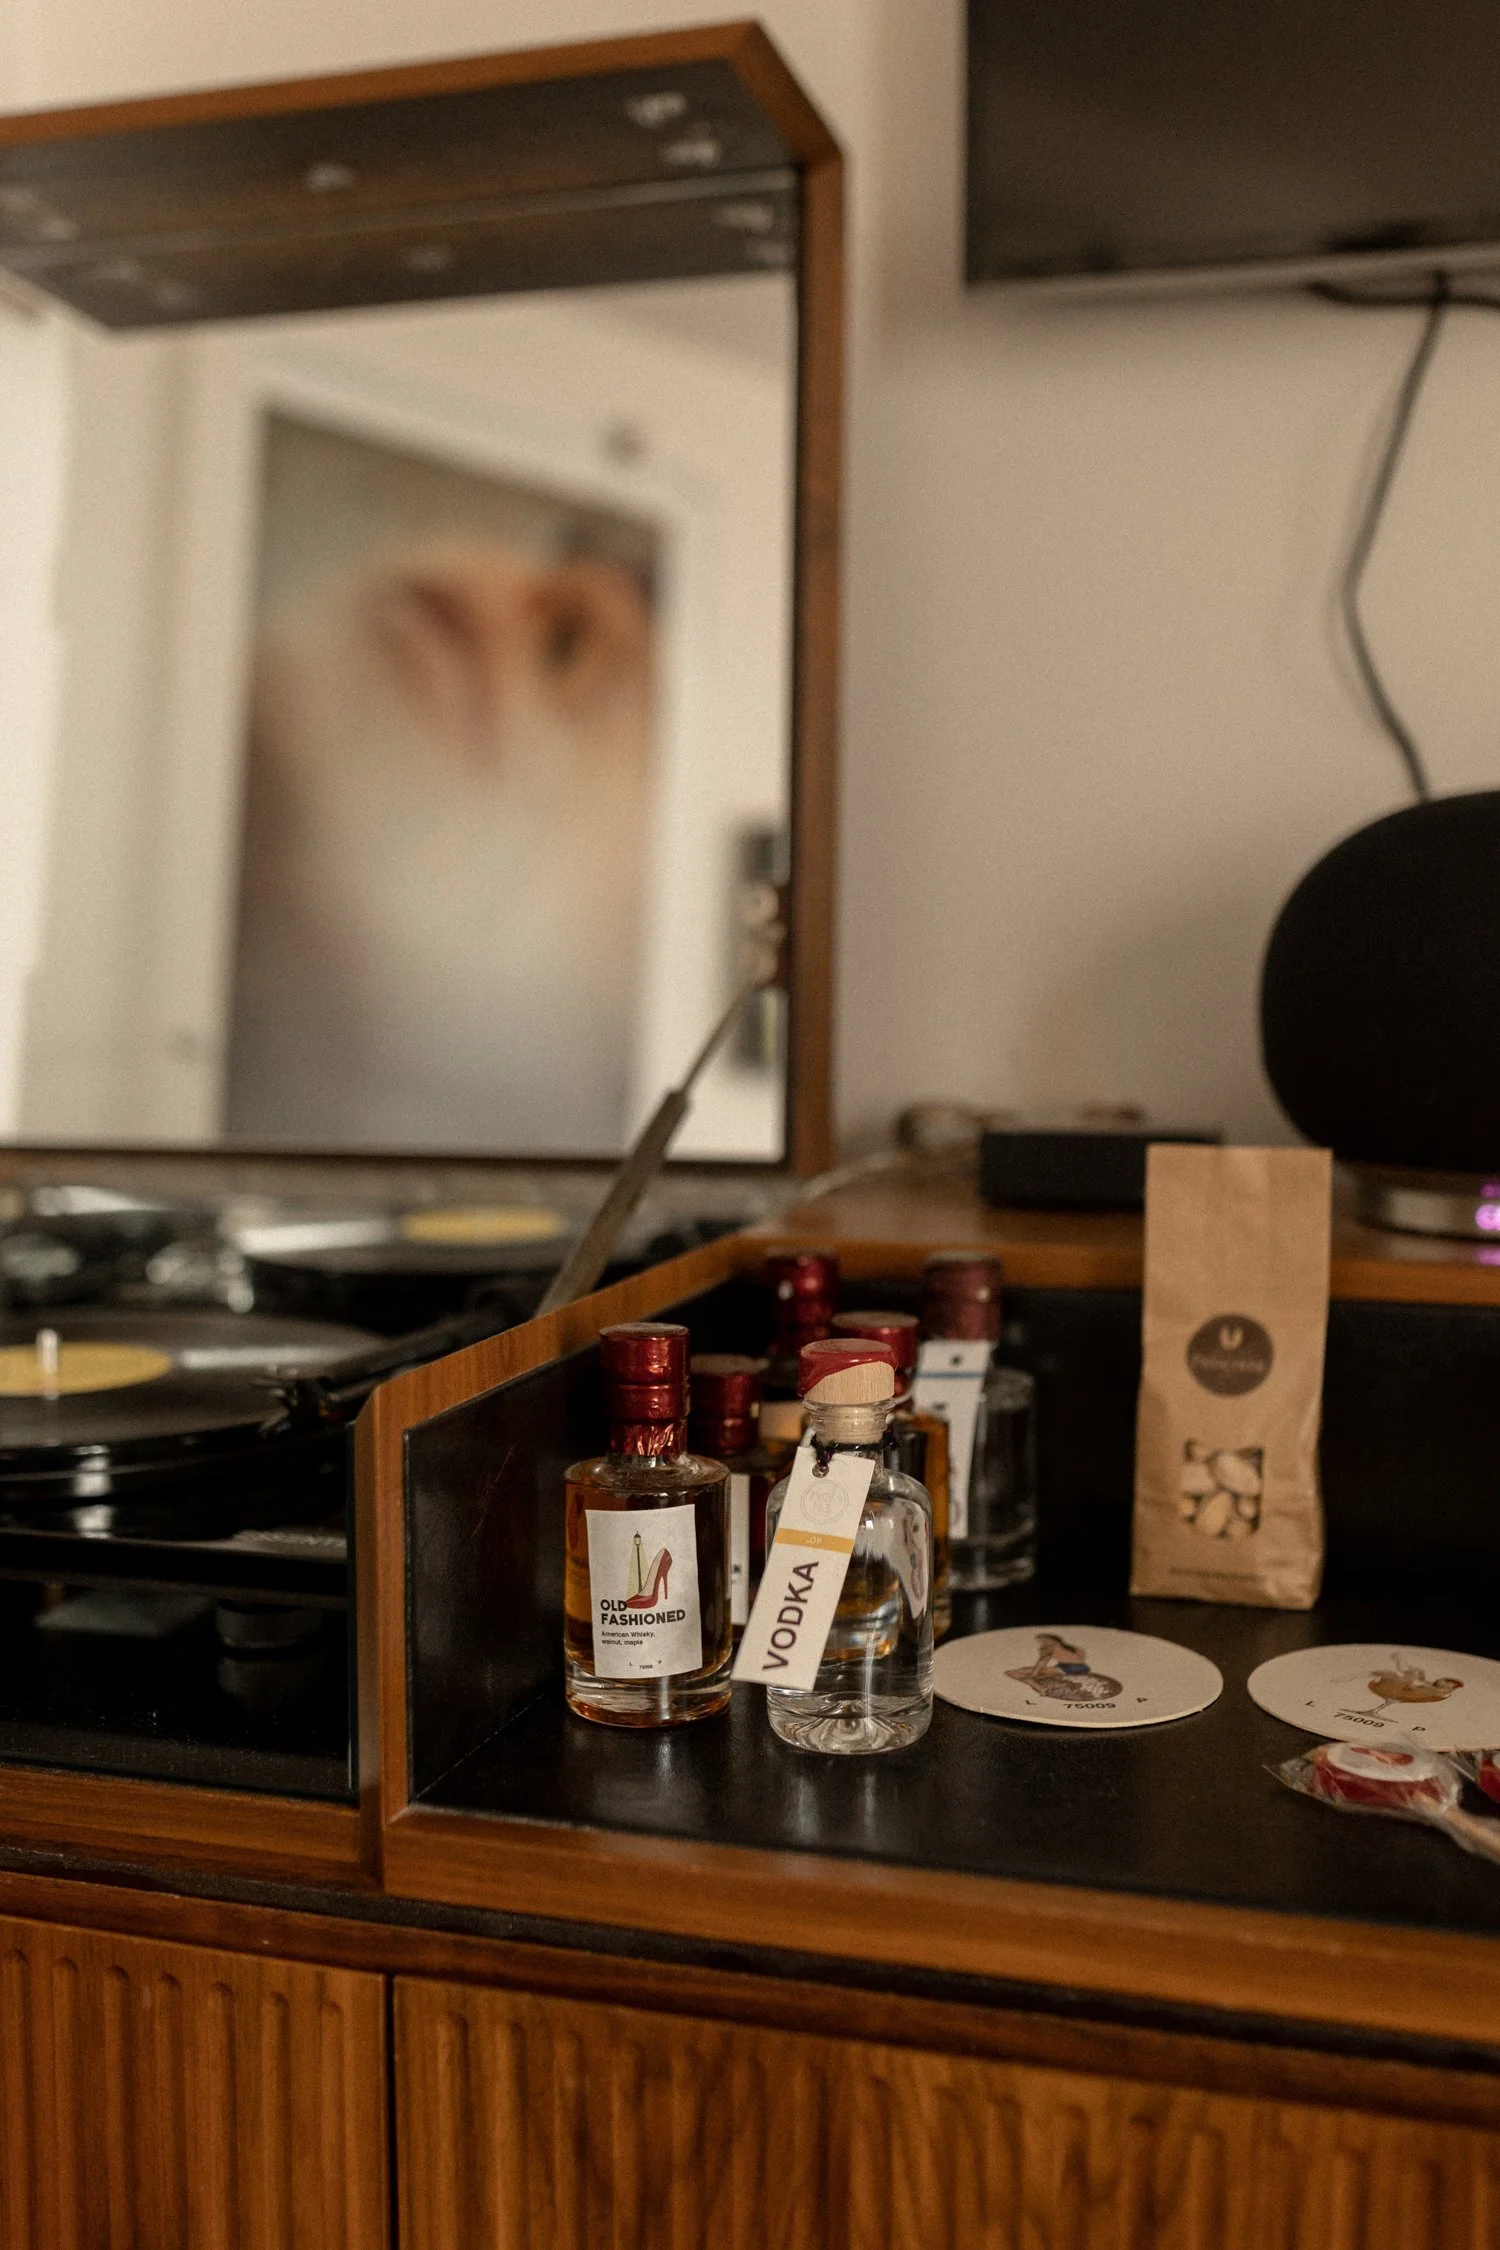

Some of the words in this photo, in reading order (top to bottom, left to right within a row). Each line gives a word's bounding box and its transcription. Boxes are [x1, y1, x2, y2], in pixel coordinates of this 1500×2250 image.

[600, 1599, 628, 1612] OLD
[601, 1609, 686, 1626] FASHIONED
[762, 1560, 820, 1671] VODKA
[1063, 1702, 1116, 1710] 75009
[1333, 1711, 1385, 1728] 75009
